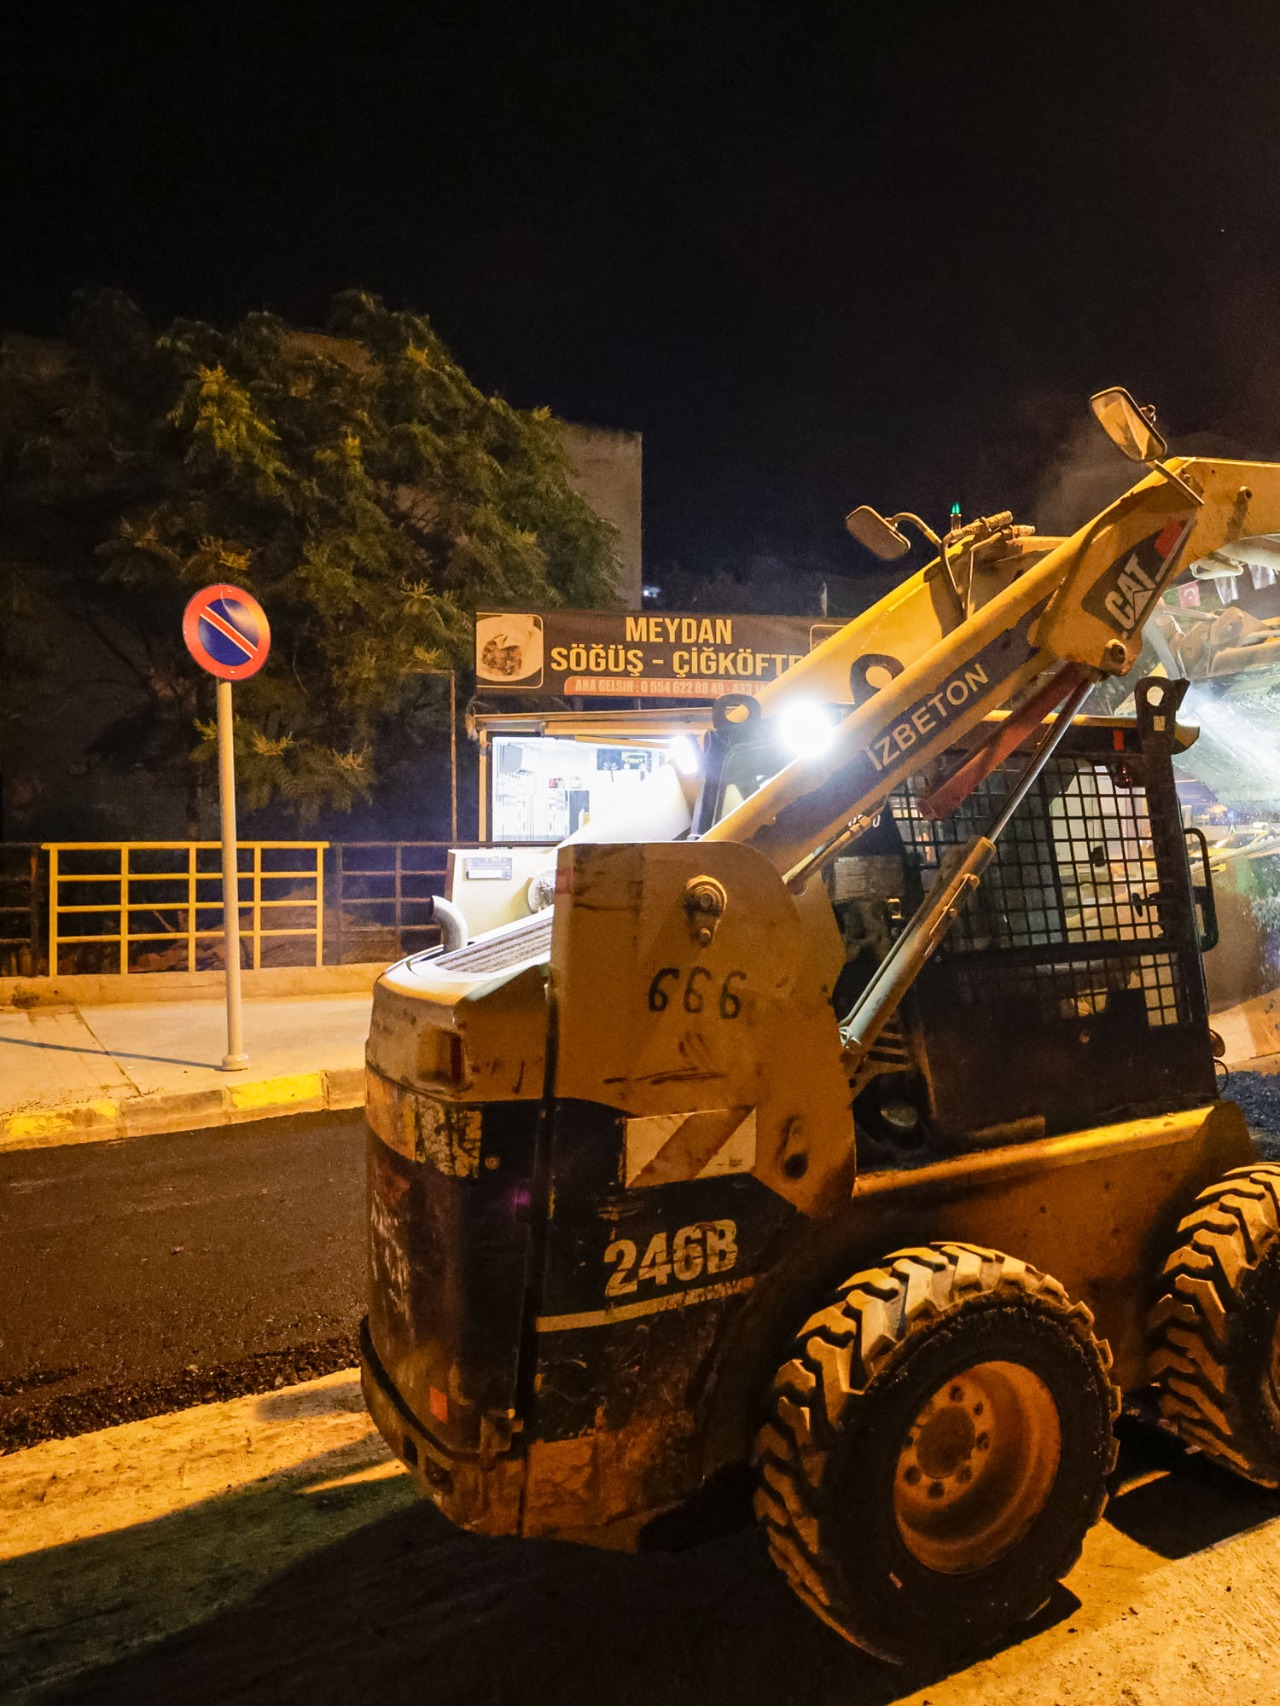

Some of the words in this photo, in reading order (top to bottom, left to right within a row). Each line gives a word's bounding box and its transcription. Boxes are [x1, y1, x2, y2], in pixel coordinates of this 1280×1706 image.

[1105, 553, 1156, 629] CAT
[625, 616, 732, 644] MEYDAN
[550, 643, 644, 677] SÖĞÜŞ
[575, 679, 596, 692] ARA
[650, 681, 671, 694] 554
[672, 681, 693, 695] 622
[694, 682, 709, 695] 88
[711, 682, 725, 695] 49
[648, 966, 747, 1019] 666
[603, 1219, 739, 1297] 246B
